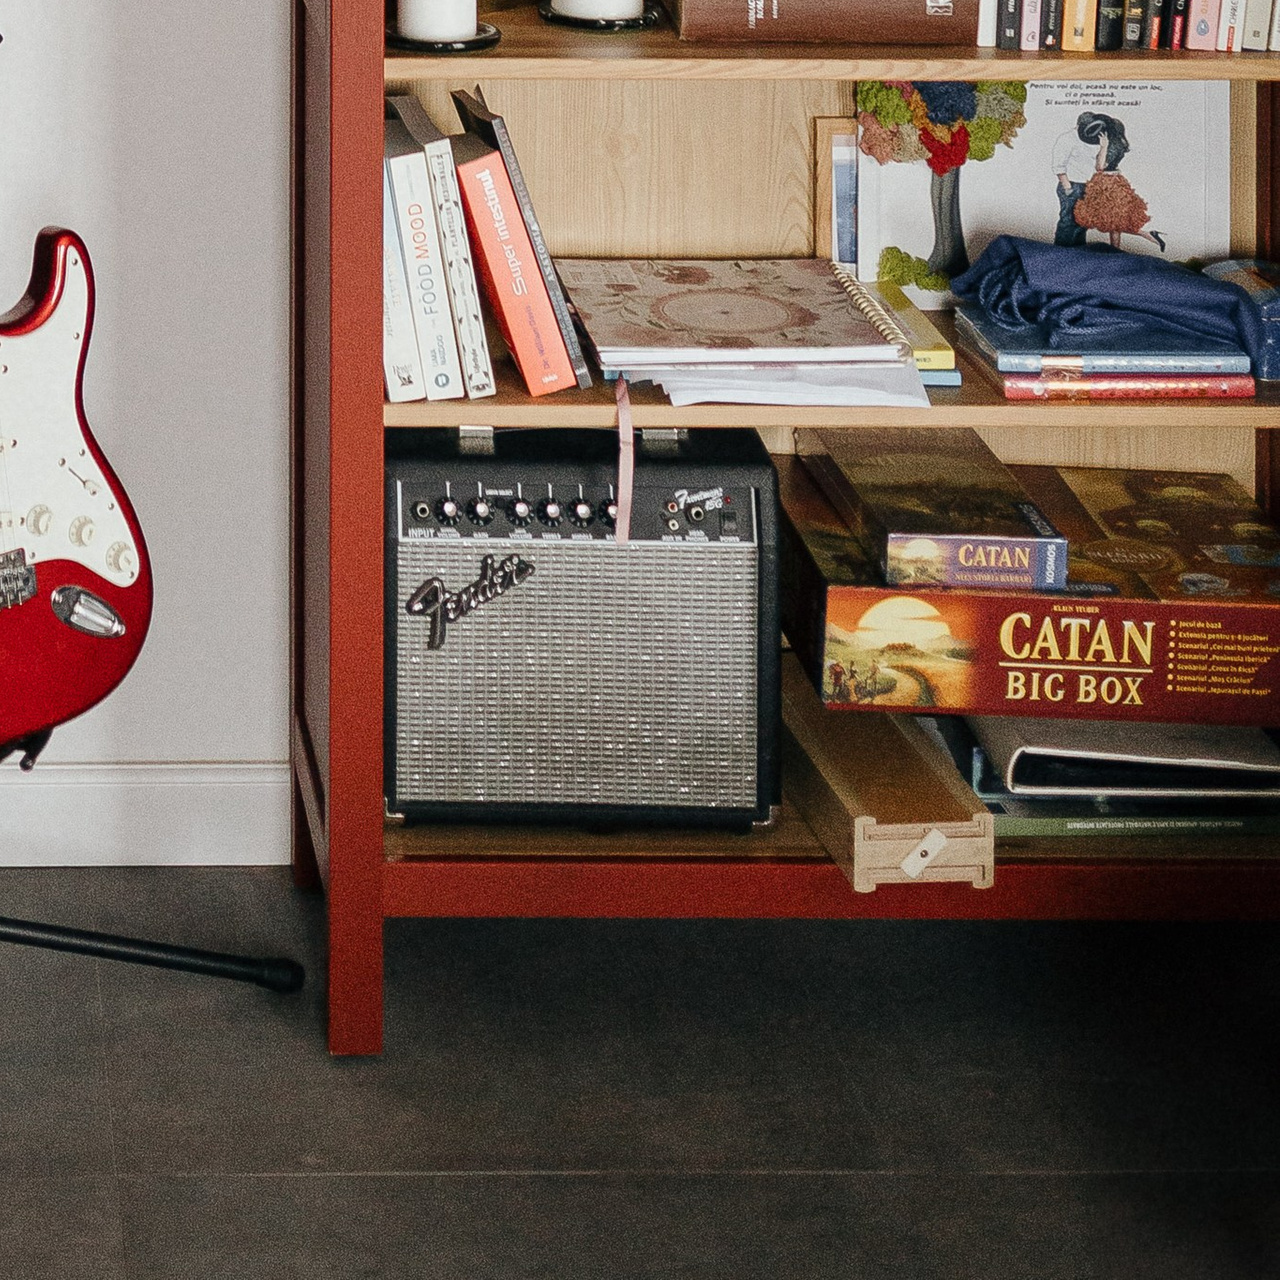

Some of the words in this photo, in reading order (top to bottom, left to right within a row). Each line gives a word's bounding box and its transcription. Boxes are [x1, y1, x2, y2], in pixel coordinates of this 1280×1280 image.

[407, 203, 430, 260] MOOD
[475, 169, 509, 242] intestinul
[417, 264, 438, 316] FOOD
[502, 244, 528, 297] Super
[532, 326, 546, 357] William
[408, 527, 435, 538] INPUT
[958, 543, 1031, 569] CATAN
[1045, 544, 1057, 584] KOSMOS
[406, 553, 536, 650] Fender
[1000, 612, 1156, 667] CATAN
[1006, 671, 1065, 703] BIG
[1076, 674, 1145, 707] BOX
